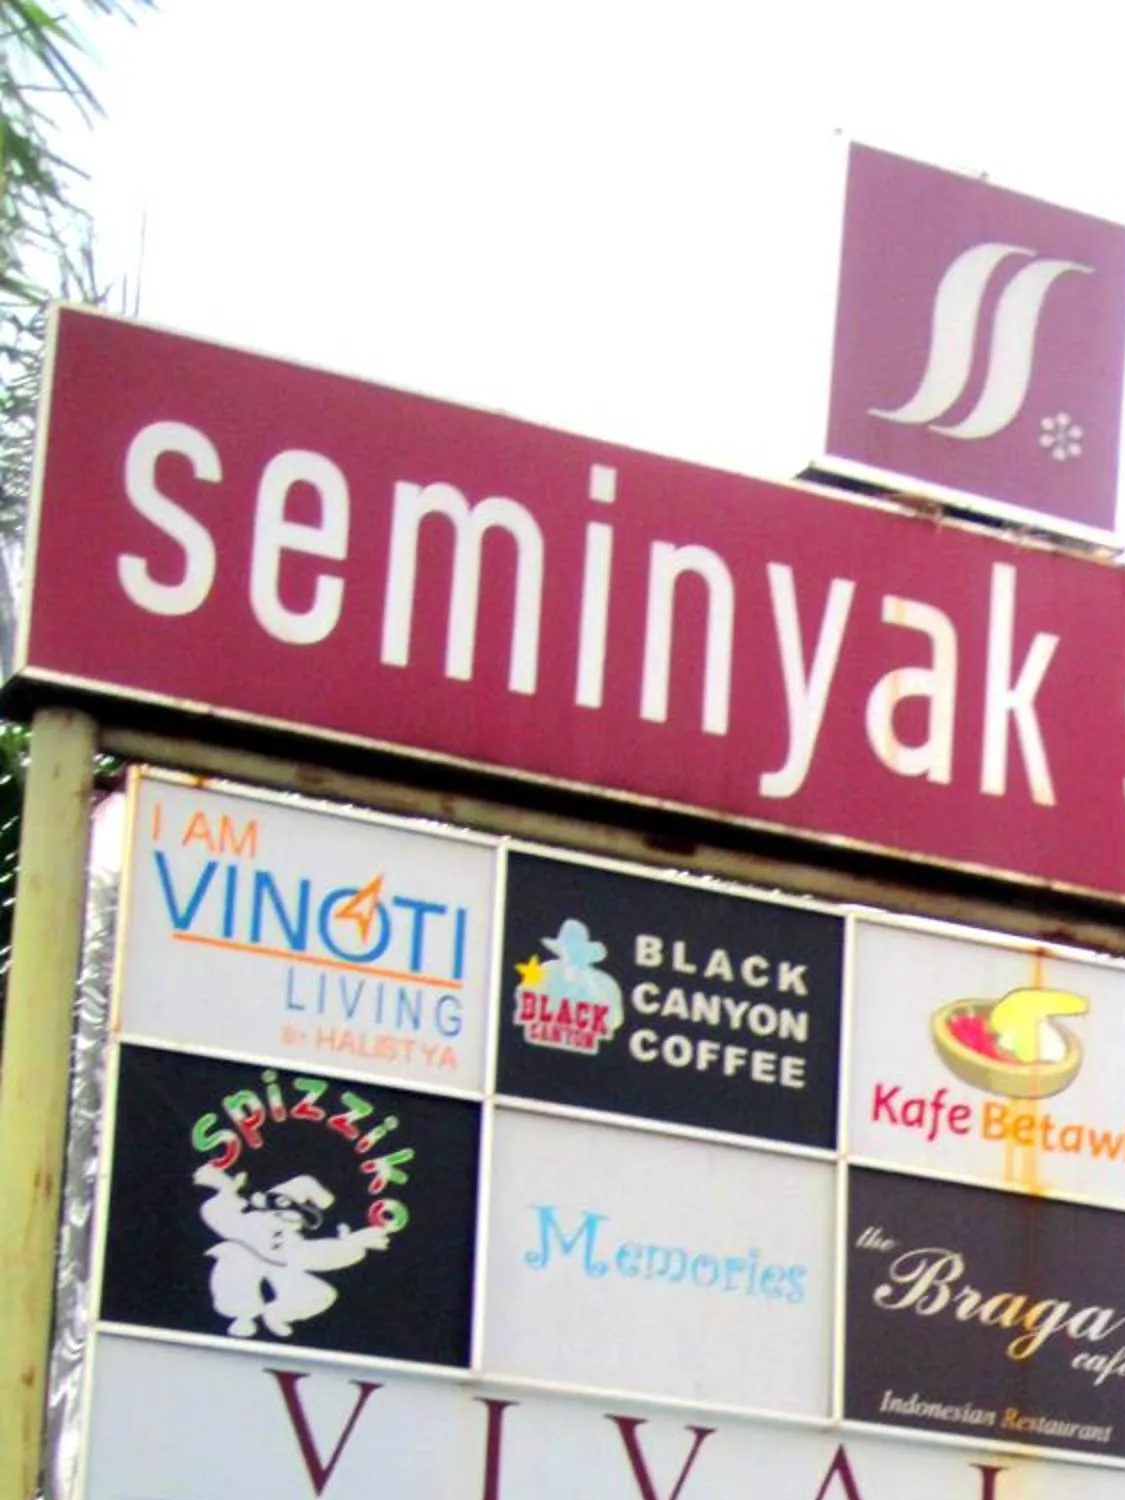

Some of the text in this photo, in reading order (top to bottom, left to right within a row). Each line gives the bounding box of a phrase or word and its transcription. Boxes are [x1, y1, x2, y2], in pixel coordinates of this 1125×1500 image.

[117, 420, 1060, 806] seminyak
[182, 809, 257, 859] AM
[154, 849, 468, 980] VINOTI
[635, 934, 809, 995] BLACK
[286, 966, 464, 1038] LIVING
[521, 990, 609, 1036] BLACK
[631, 982, 809, 1042] CANYON
[629, 1029, 806, 1088] COFFEE
[871, 1082, 972, 1142] Kafe
[524, 1203, 809, 1304] Memories
[856, 1225, 896, 1252] the
[879, 1389, 1113, 1443] Indonesian Restaurant
